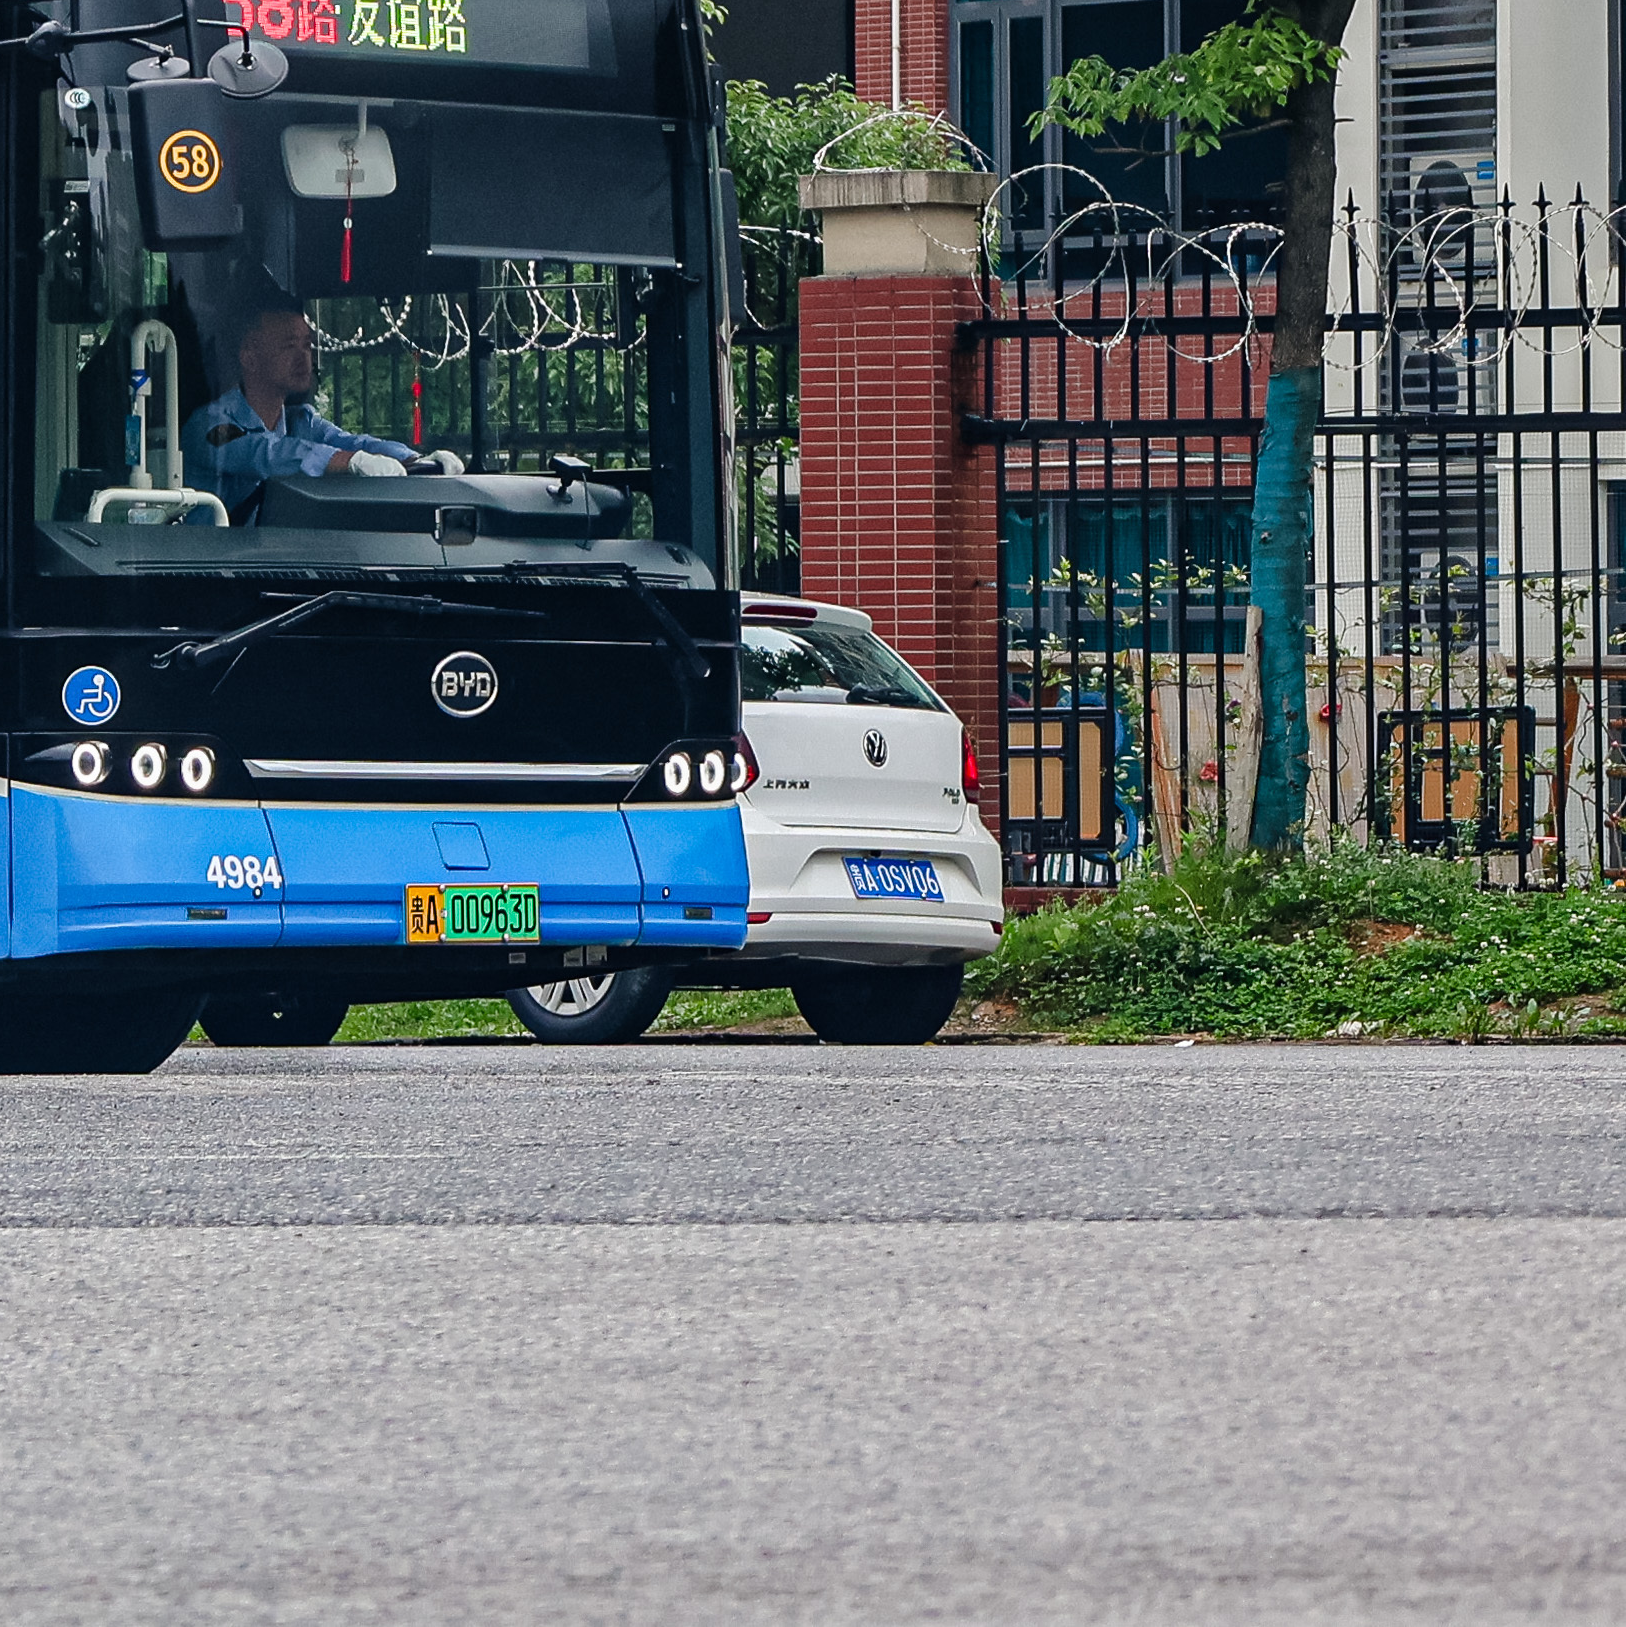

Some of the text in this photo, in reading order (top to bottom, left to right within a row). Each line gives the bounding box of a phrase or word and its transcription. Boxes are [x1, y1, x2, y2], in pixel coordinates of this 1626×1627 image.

[171, 144, 210, 179] 58
[441, 671, 491, 697] BYD
[206, 855, 283, 890] 4984
